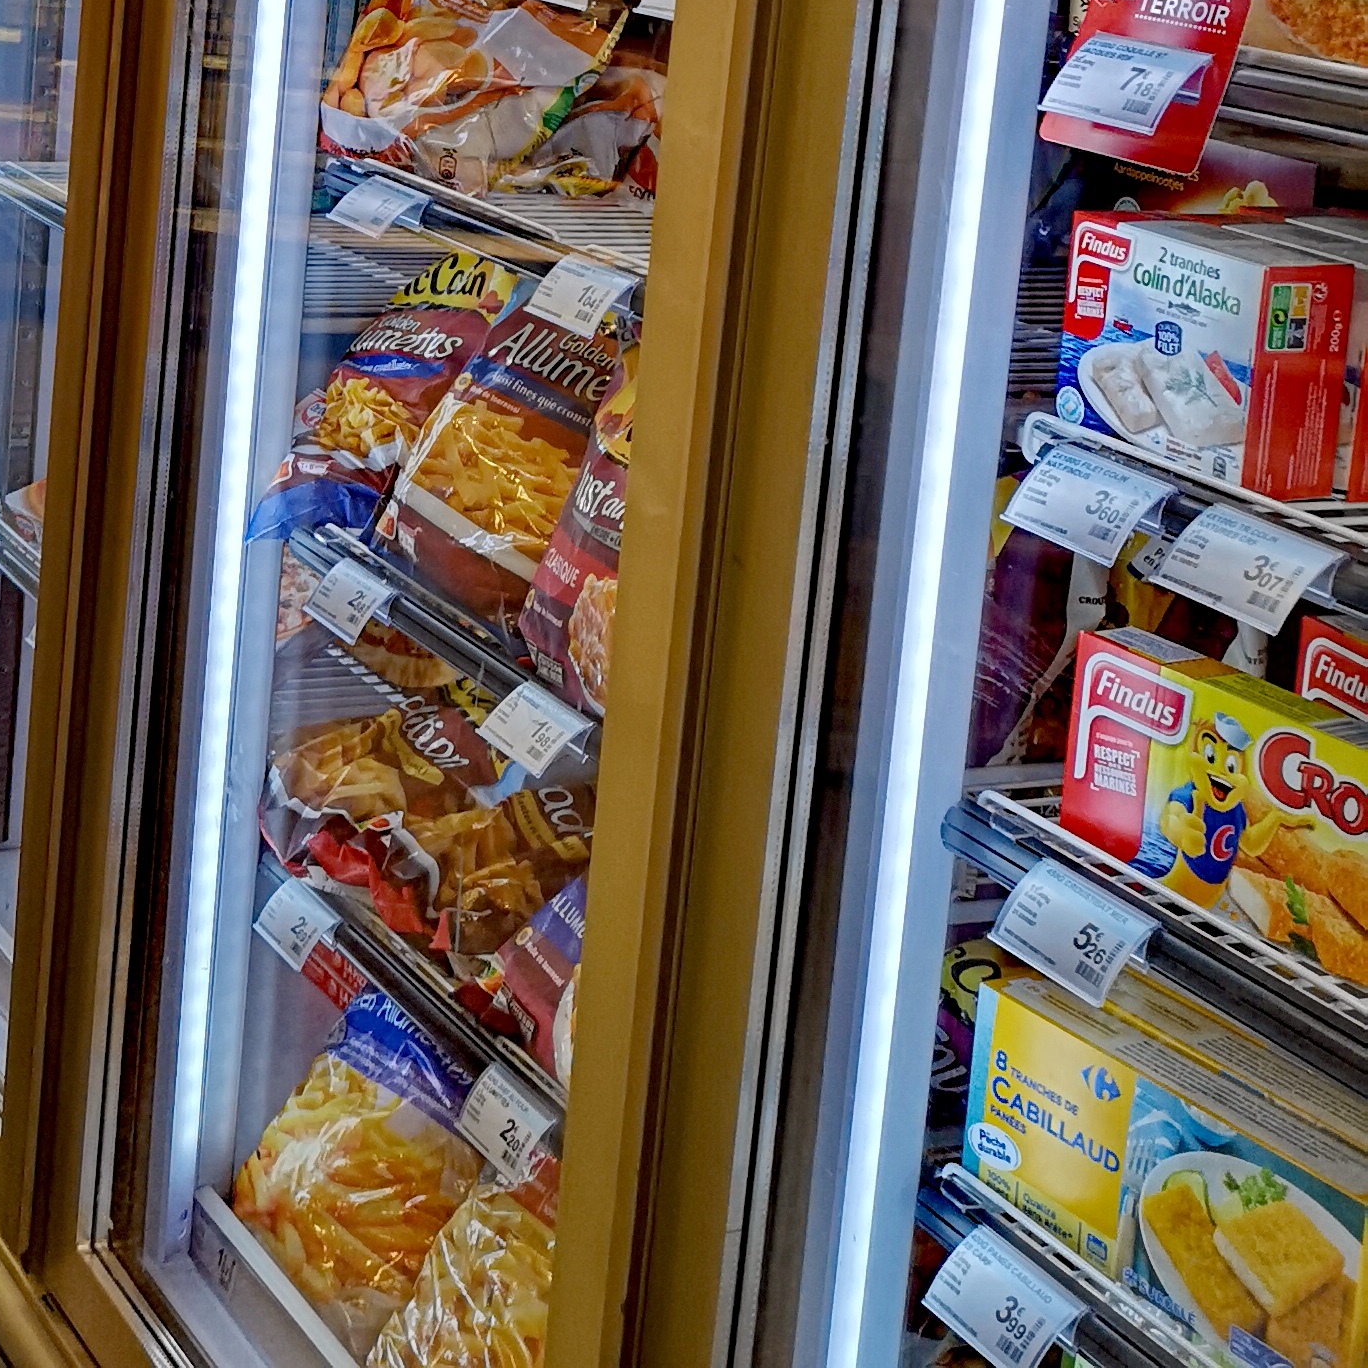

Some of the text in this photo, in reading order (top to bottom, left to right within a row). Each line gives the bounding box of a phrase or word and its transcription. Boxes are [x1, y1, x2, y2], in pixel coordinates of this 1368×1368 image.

[1080, 231, 1127, 263] Findus
[1158, 246, 1221, 280] 2 tranches
[1133, 262, 1242, 316] Colin d'Alaska
[1096, 669, 1177, 728] Findus
[1093, 743, 1136, 769] RESPECT
[994, 1049, 1080, 1117] 8 TRANCHES DE
[991, 1075, 1120, 1173] CABILLAUD
